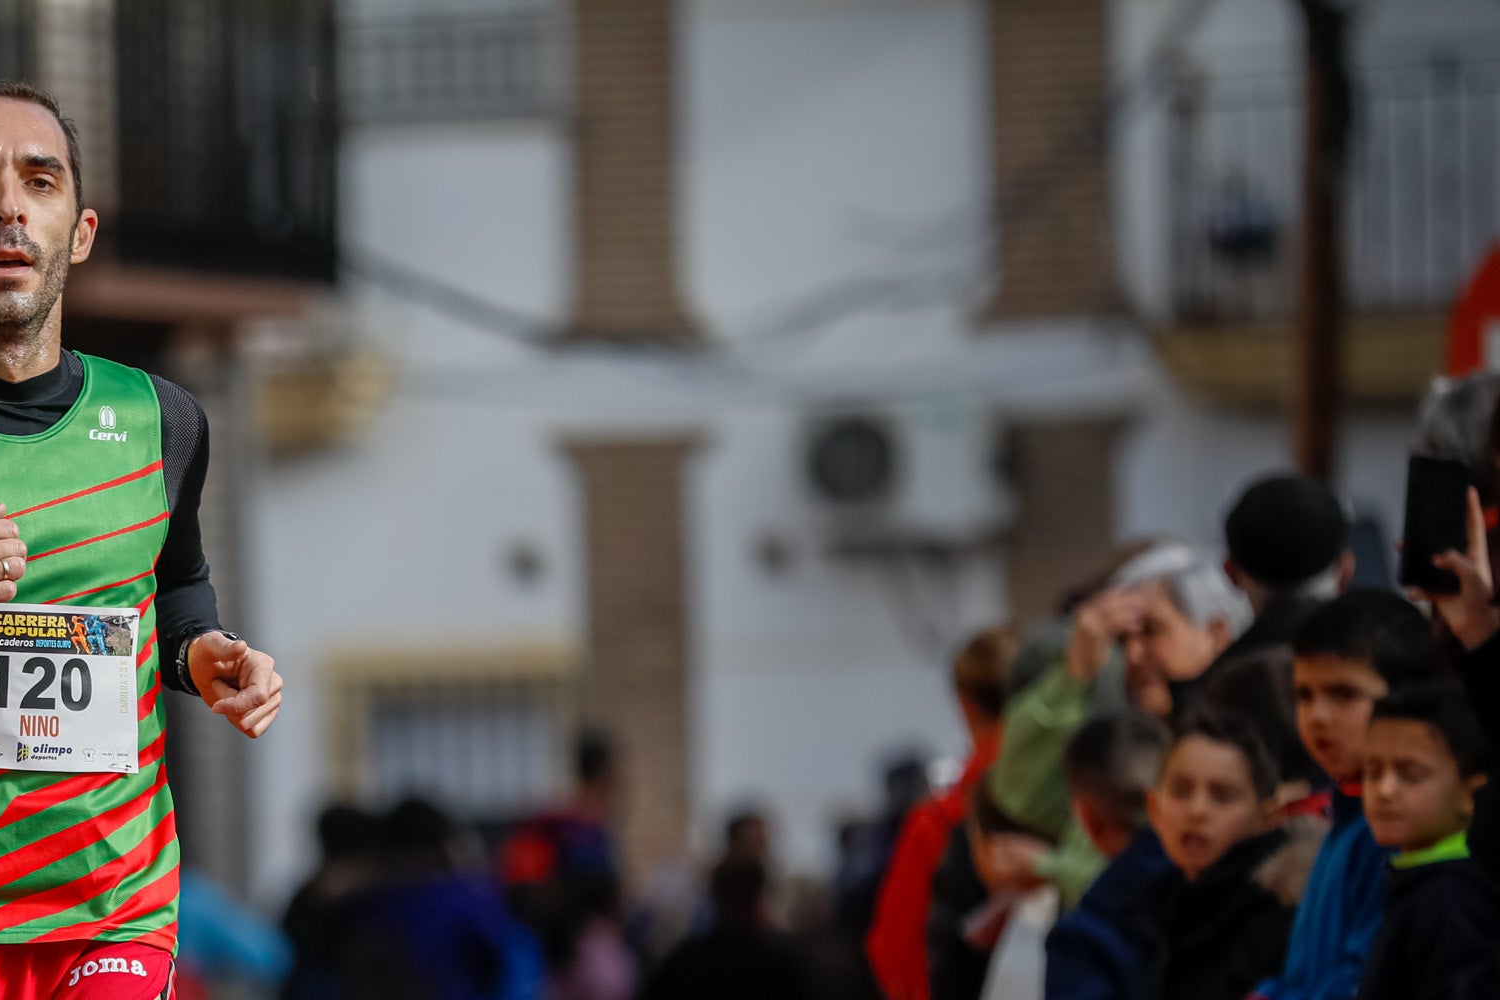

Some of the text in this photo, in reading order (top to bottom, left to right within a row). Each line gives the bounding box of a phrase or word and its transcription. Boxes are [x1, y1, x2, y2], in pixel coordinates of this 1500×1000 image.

[88, 428, 128, 443] Cervi
[19, 714, 60, 737] NINO
[32, 743, 73, 756] olimpo
